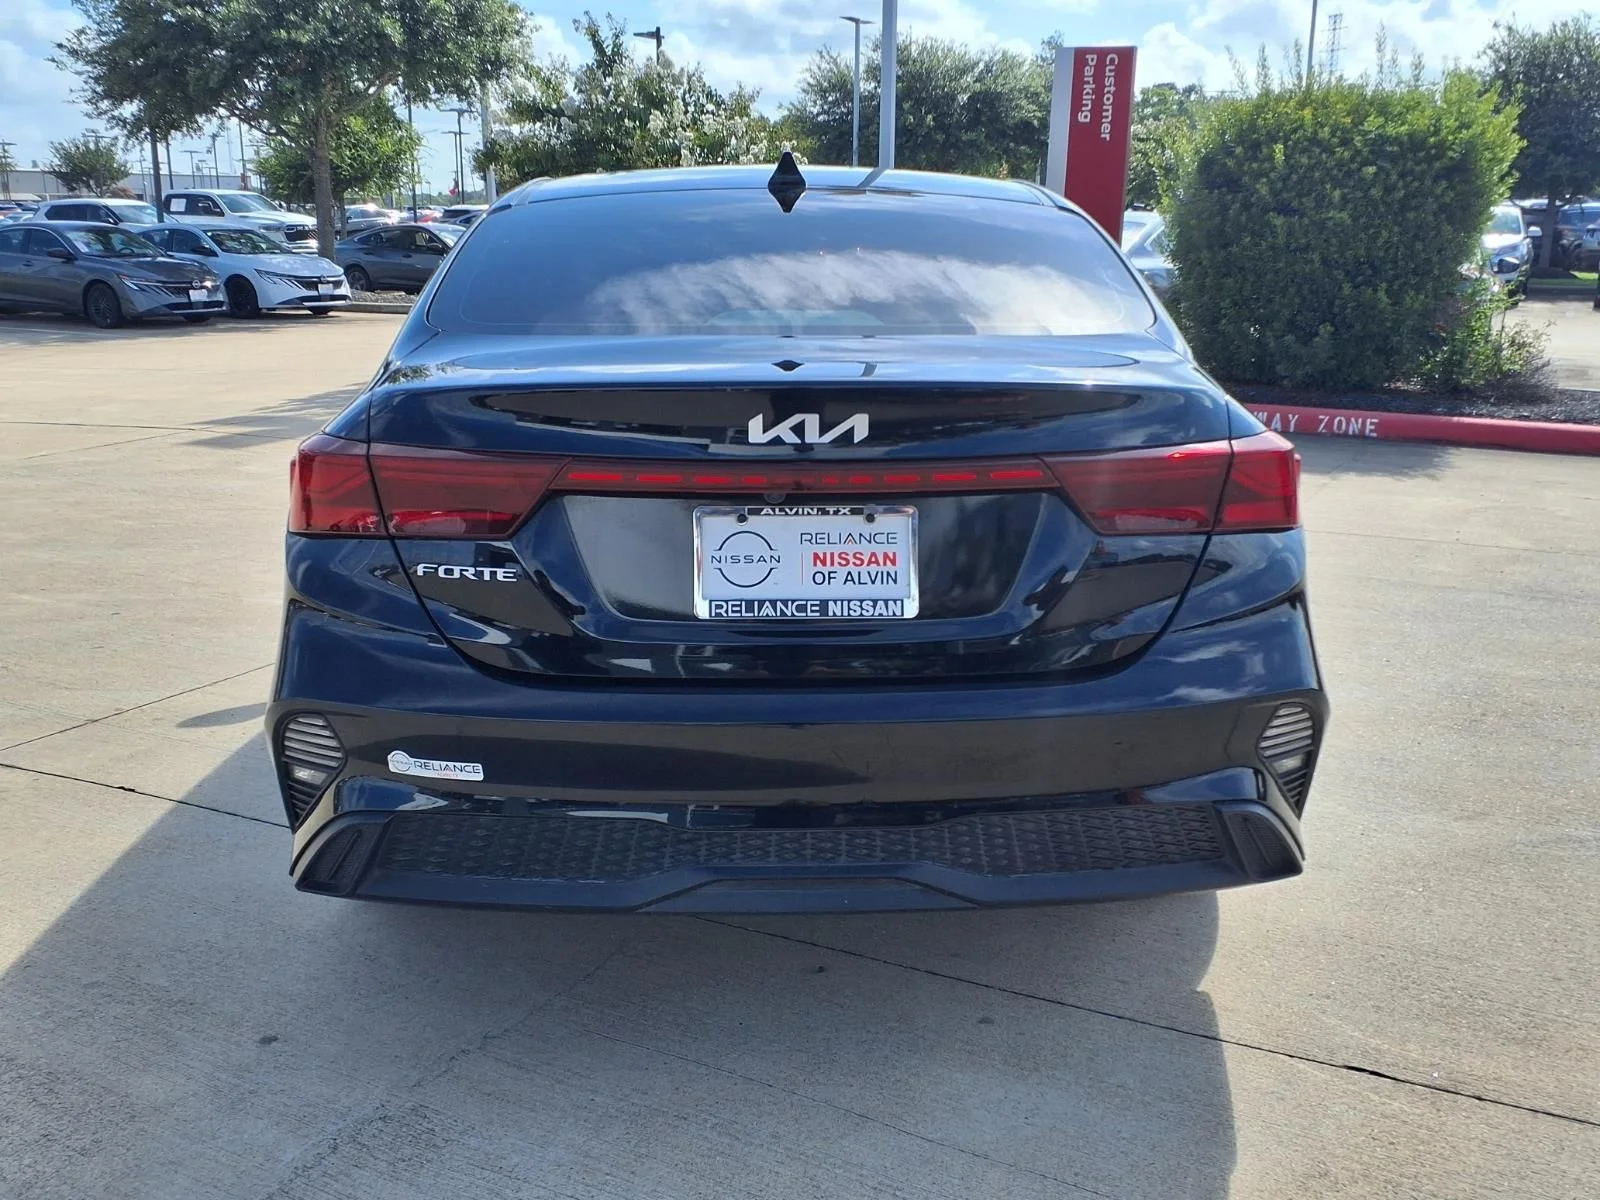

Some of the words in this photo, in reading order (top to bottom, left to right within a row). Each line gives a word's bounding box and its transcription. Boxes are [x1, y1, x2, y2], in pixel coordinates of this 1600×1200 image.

[1078, 54, 1097, 123] Parking
[1100, 53, 1119, 141] Customer
[748, 413, 869, 444] KIA
[1316, 415, 1379, 438] ZONE
[825, 507, 851, 515] TX
[800, 532, 898, 545] RELIANCE
[711, 554, 781, 564] NISSAN
[812, 551, 897, 567] NISSAN
[416, 563, 518, 582] FORTE
[812, 570, 837, 586] OF
[843, 570, 898, 585] ALVIN
[711, 600, 820, 617] RELIANCE
[828, 600, 902, 617] NISSAN
[413, 760, 481, 774] RELIANCE
